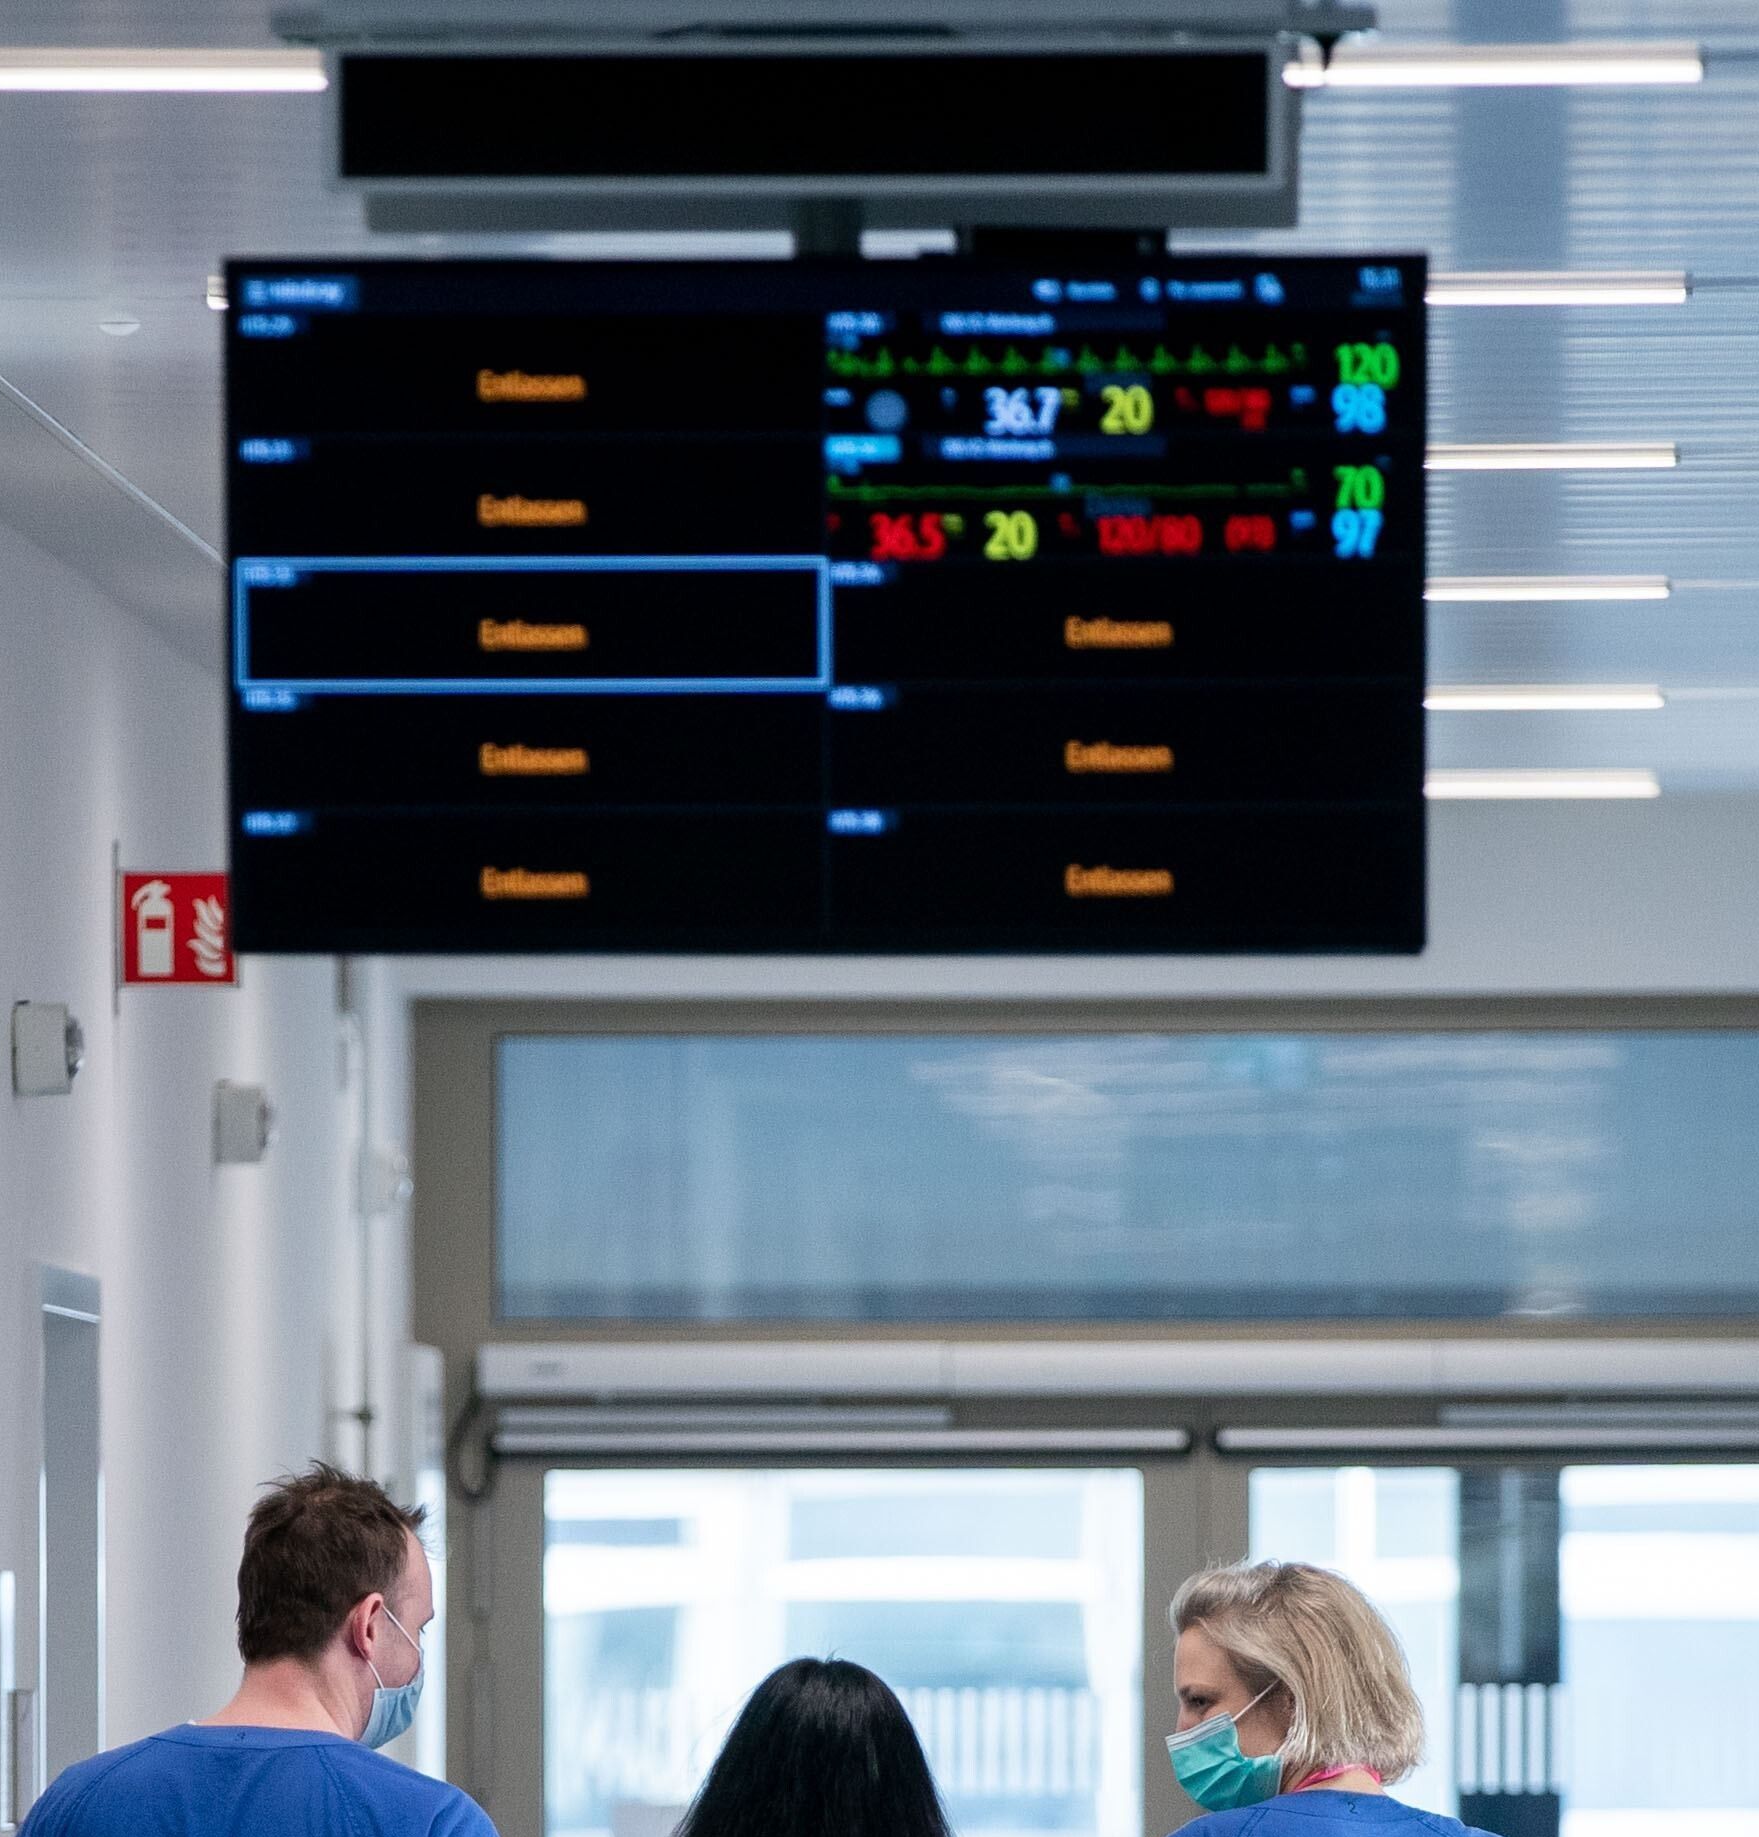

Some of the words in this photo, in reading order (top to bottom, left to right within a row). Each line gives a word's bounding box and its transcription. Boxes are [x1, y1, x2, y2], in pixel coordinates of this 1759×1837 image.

[1334, 344, 1398, 387] 120
[984, 387, 1062, 435] 36.7
[1103, 386, 1151, 433] 20
[1332, 385, 1385, 433] 98
[1336, 466, 1383, 508] 70
[872, 513, 944, 560] 36.5
[986, 511, 1036, 559] 20
[1332, 510, 1382, 557] 97
